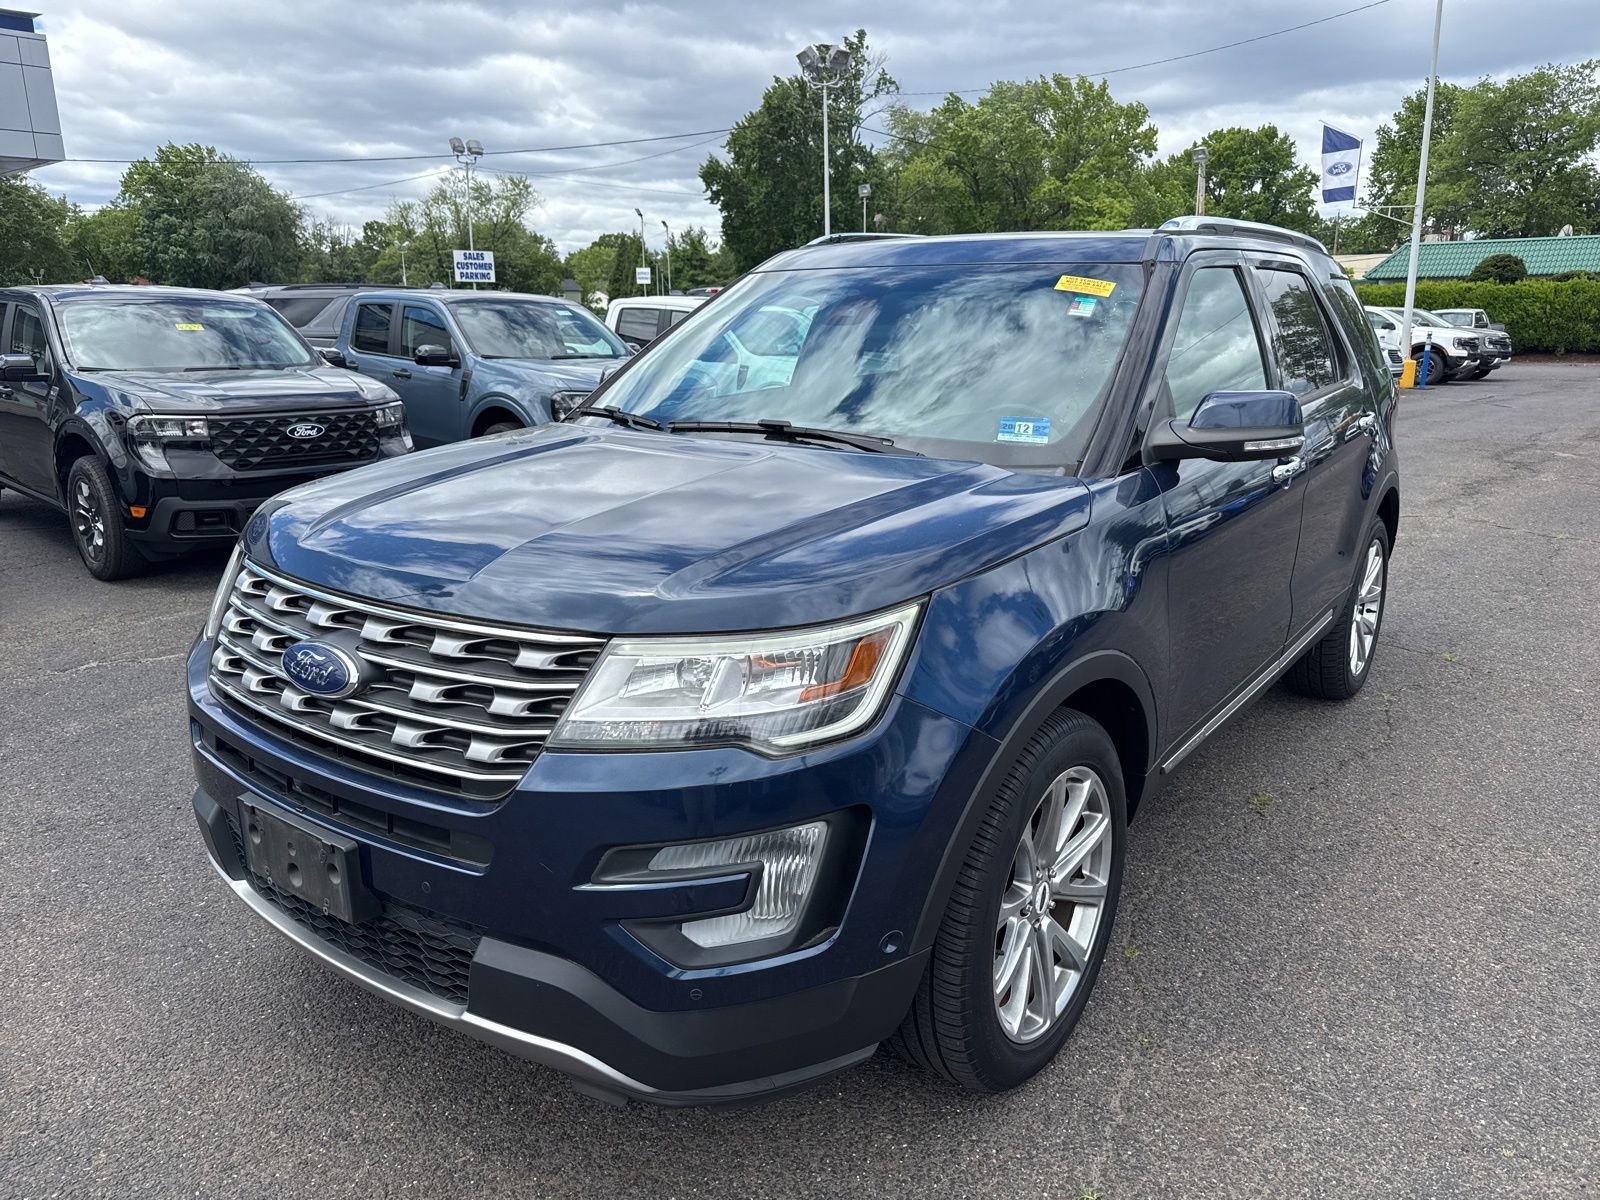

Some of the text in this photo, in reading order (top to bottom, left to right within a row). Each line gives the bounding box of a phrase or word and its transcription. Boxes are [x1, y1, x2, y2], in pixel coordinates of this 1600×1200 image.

[463, 252, 485, 261] SALES
[456, 262, 493, 271] CUSTOMER
[460, 272, 491, 280] PARKING
[294, 425, 318, 436] Ford
[1017, 423, 1030, 433] 12
[290, 649, 335, 686] Ford
